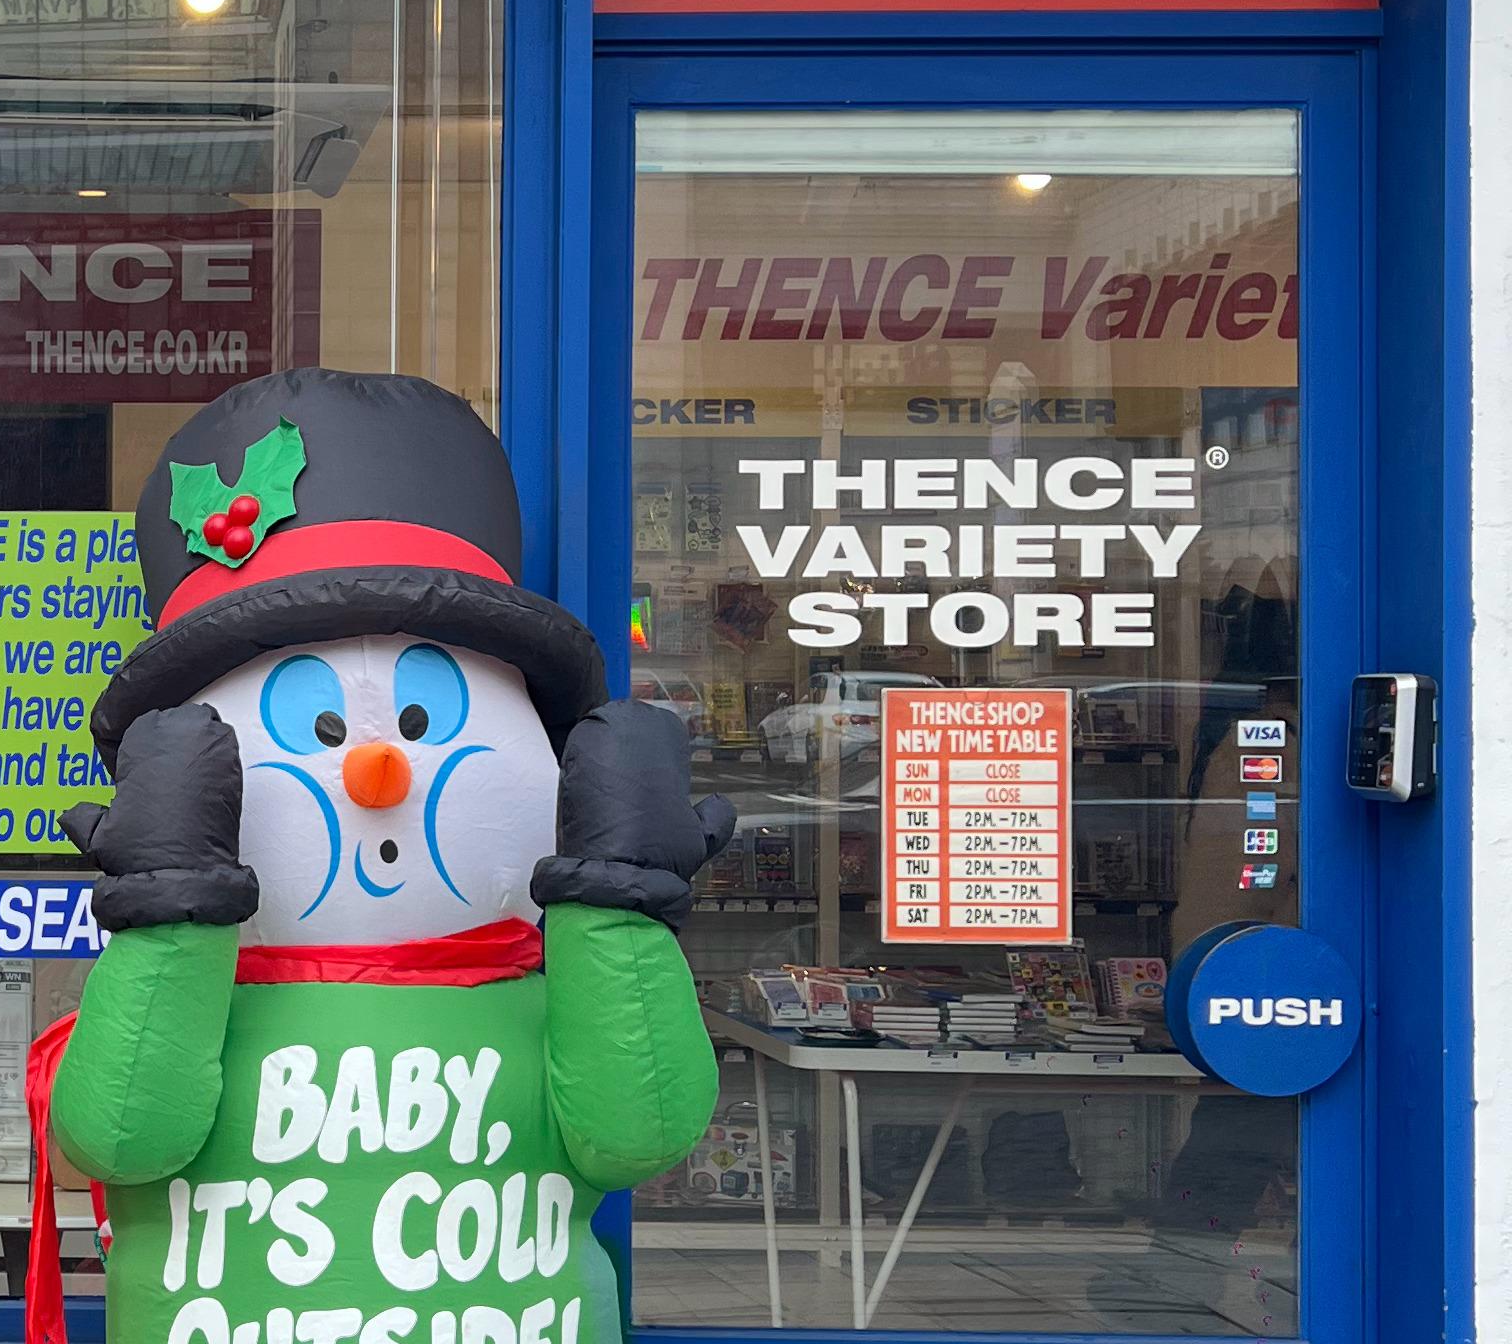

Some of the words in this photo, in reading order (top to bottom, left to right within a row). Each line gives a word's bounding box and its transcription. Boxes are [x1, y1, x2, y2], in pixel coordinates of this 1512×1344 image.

[640, 255, 1014, 342] THENCE
[25, 329, 249, 375] THENCE.CO.KR
[906, 397, 1117, 426] STICKER
[738, 456, 1196, 511] THENCE
[17, 518, 46, 563] is
[55, 528, 77, 563] a
[735, 525, 1203, 578] VARIETY
[787, 592, 1155, 648] STORE
[4, 639, 53, 675] we
[64, 639, 122, 675] are
[1, 687, 84, 731] have
[909, 701, 983, 725] THENCE
[988, 701, 1045, 726] SHOP
[896, 730, 942, 753] NEW
[1243, 727, 1281, 739] VISA
[57, 743, 116, 787] tak
[905, 763, 929, 778] SUN
[985, 763, 1021, 779] CLOSE
[903, 787, 932, 802] MON
[985, 787, 1021, 803] CLOSE
[907, 811, 928, 826] TUE
[905, 836, 930, 851] WED
[906, 860, 930, 875] THU
[909, 884, 927, 900] FRI
[908, 908, 929, 924] SAT
[1209, 997, 1343, 1026] PUSH
[252, 1045, 512, 1165] BABY,
[163, 1177, 336, 1292] IT'S
[372, 1171, 575, 1291] COLD
